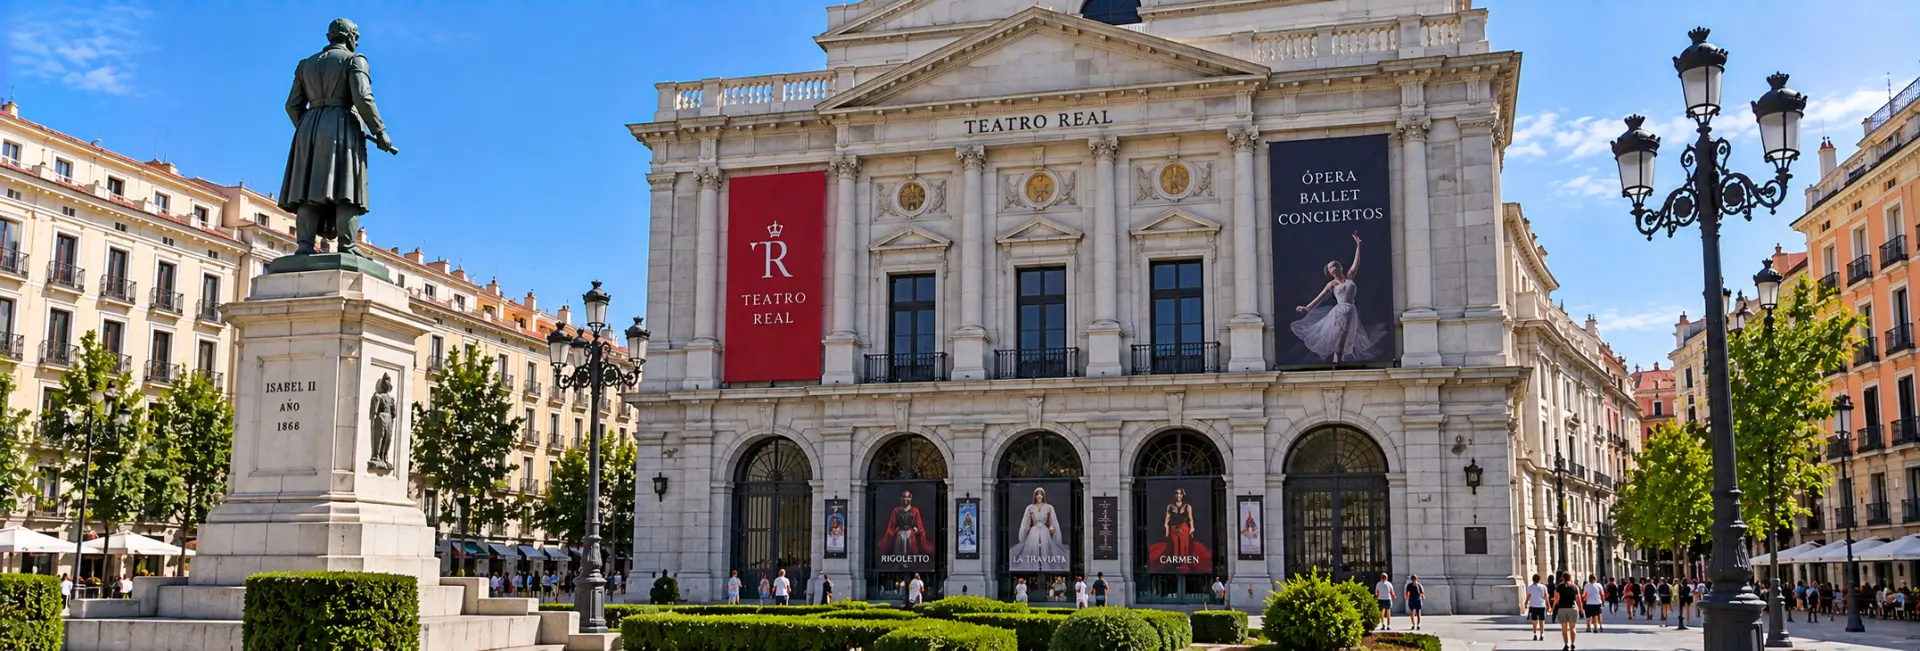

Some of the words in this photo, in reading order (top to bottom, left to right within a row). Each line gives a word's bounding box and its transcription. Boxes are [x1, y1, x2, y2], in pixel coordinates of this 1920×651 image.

[964, 114, 1047, 134] TEATRO
[1058, 110, 1113, 127] REAL
[1302, 170, 1357, 185] ÓPERA
[1300, 189, 1360, 204] BALLET
[1279, 207, 1383, 225] CONCIERTOS
[742, 292, 806, 306] TEATRO
[753, 312, 794, 324] REAL
[265, 382, 303, 393] ISABEL
[308, 381, 316, 391] II
[881, 554, 930, 563] RIGOLETTO
[1013, 555, 1023, 563] LA
[1025, 555, 1067, 563] TRAVIATA
[1159, 555, 1199, 564] CARMEN
